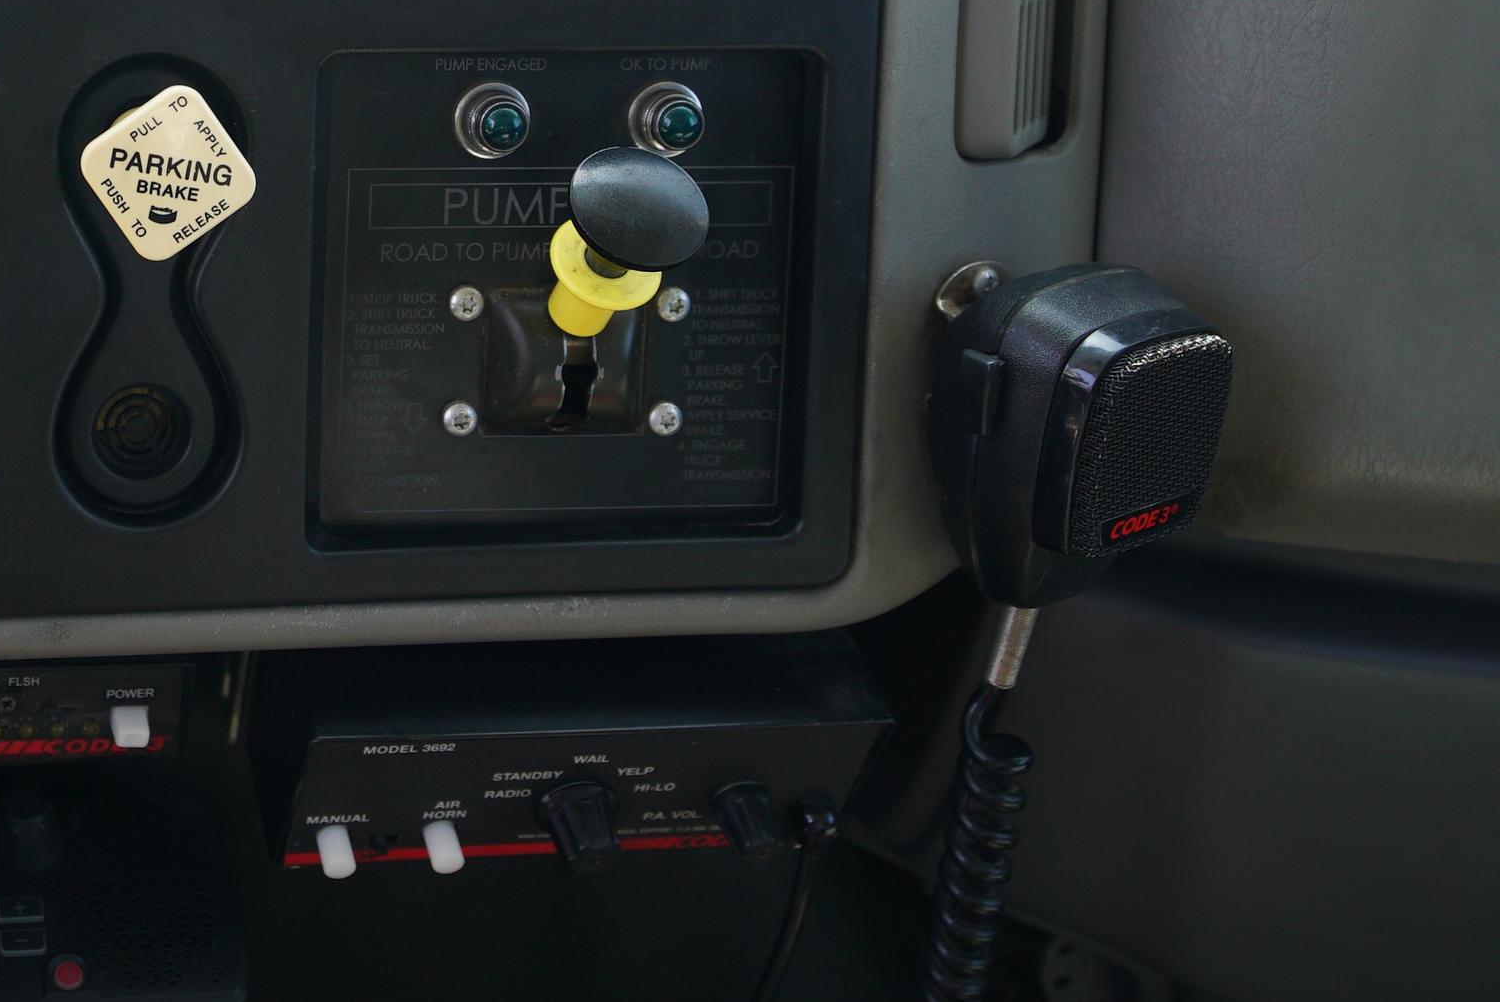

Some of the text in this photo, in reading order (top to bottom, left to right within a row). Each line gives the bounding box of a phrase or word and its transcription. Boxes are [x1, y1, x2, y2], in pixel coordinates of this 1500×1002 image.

[435, 57, 548, 72] PUMP ENGAGED
[620, 57, 710, 71] OK TO PUMP
[129, 95, 227, 158] PULL TO APPLY
[109, 147, 232, 186] PARKING
[136, 180, 199, 202] BRAKE
[100, 178, 230, 243] PUSH TO RELEASE
[380, 242, 447, 263] ROAD
[455, 241, 485, 262] TO
[363, 293, 394, 305] STOP
[708, 288, 737, 300] SHIFT
[740, 288, 779, 299] TRUCK
[361, 308, 392, 319] SHIFT
[396, 307, 436, 319] TRUCK
[692, 304, 780, 315] TRANSMISSION
[354, 323, 445, 335] TRANSMISSION
[697, 334, 743, 346] THROW
[745, 333, 781, 345] LEVER
[695, 364, 746, 375] RELEASE
[687, 379, 743, 391] PARKING
[726, 408, 777, 421] SERVICE
[1110, 508, 1160, 540] CODE
[8, 676, 41, 688] FLSH
[105, 687, 155, 699] POWER
[363, 743, 457, 756] MODEL 3692
[573, 754, 609, 765] WAIL
[491, 770, 565, 782] STANDBY
[616, 766, 655, 777] YELP
[633, 782, 676, 793] HI-LO
[483, 789, 532, 800] RADIO
[434, 800, 461, 810] AIR
[306, 813, 371, 825] MANUAL
[422, 809, 468, 820] HORN
